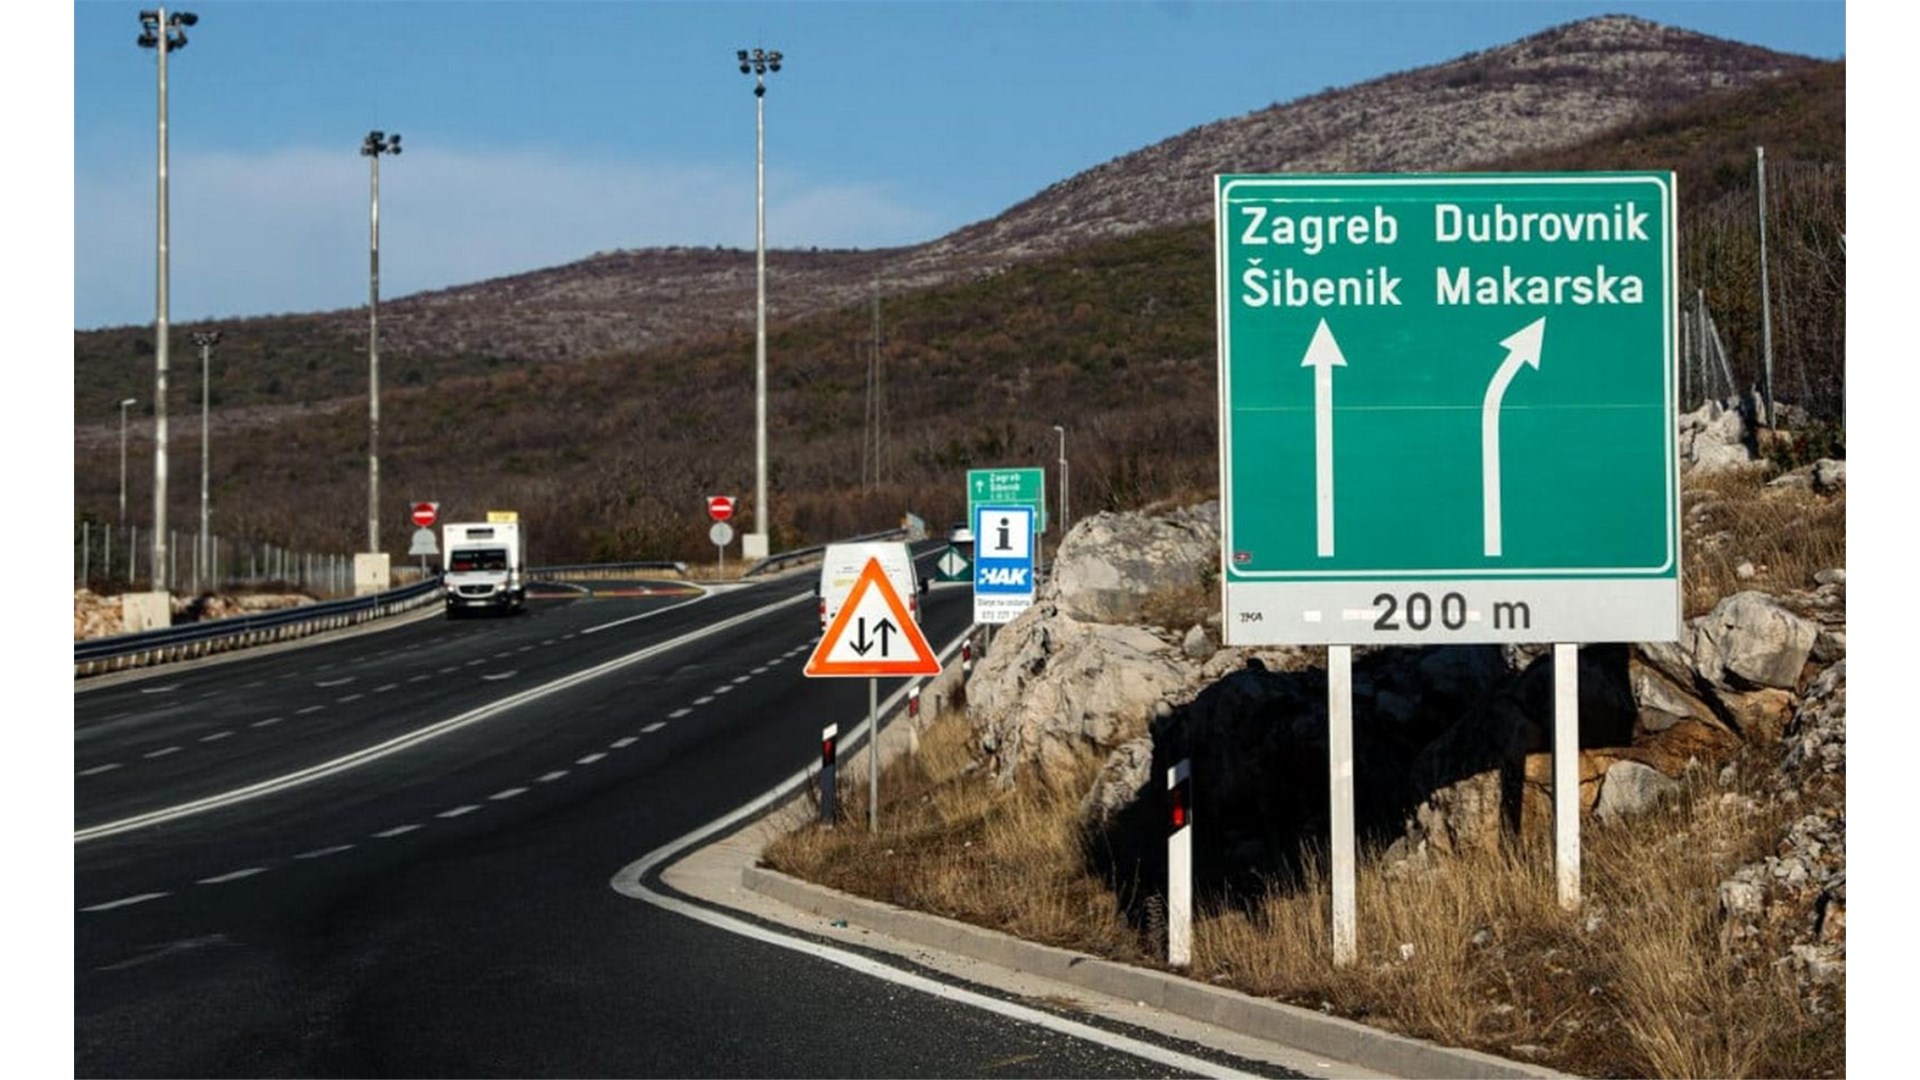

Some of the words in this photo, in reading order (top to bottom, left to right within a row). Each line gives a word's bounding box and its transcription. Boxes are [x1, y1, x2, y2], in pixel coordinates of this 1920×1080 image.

[1241, 206, 1399, 255] Zagreb
[1435, 202, 1650, 243] Dubrovnik
[1242, 258, 1402, 307] Šibenik
[1436, 265, 1644, 306] Makarska
[1373, 592, 1466, 631] 200
[1493, 602, 1531, 630] m
